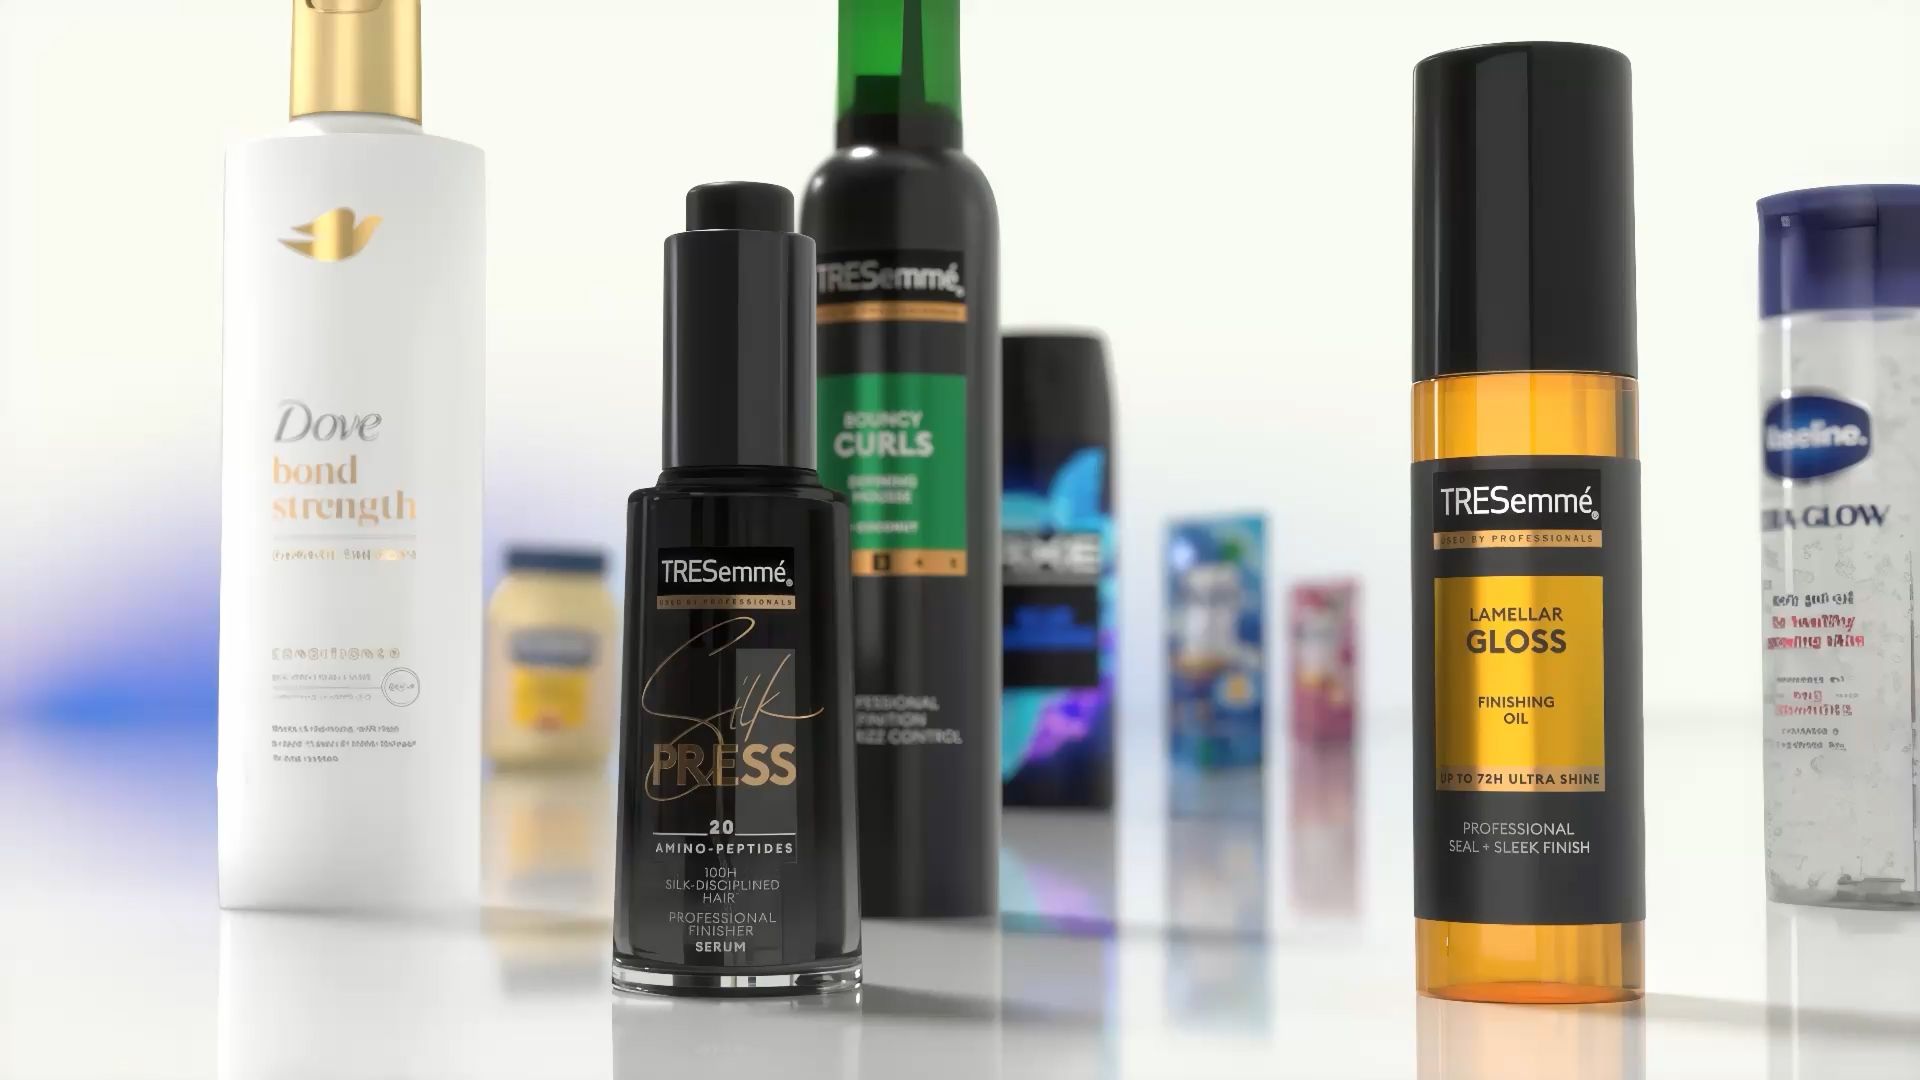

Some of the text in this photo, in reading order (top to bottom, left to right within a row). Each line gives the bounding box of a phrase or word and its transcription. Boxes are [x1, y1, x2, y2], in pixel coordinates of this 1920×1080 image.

[274, 399, 383, 443] Dove
[833, 430, 935, 458] CURLS
[273, 454, 358, 484] bond
[272, 489, 417, 527] strength
[1440, 485, 1592, 516] TRESemmé
[1802, 504, 1890, 527] GLOW
[1441, 534, 1593, 544] USED BY PROFESSIONALS
[661, 558, 786, 583] TRESemmé
[1469, 607, 1563, 622] LAMELLAR
[1466, 629, 1567, 654] GLOSS
[1478, 696, 1555, 708] FINISHING
[1503, 713, 1529, 724] OIL
[652, 743, 797, 786] PRESS
[1441, 773, 1600, 784] UP TO 72H ULTRA SHINE
[709, 819, 734, 835] 20
[1463, 822, 1575, 835] PROFESSIONAL
[655, 843, 793, 854] AMINO-PEPTIDES
[1449, 839, 1479, 853] SEAL
[1494, 841, 1539, 854] SLEEK
[1543, 841, 1590, 854] FINISH
[705, 867, 737, 878] 100H
[665, 879, 780, 891] SILK-DISCIPLINED
[669, 911, 777, 924] PROFESSIONAL
[689, 925, 754, 937] FINISHER
[695, 941, 746, 953] SERUM
